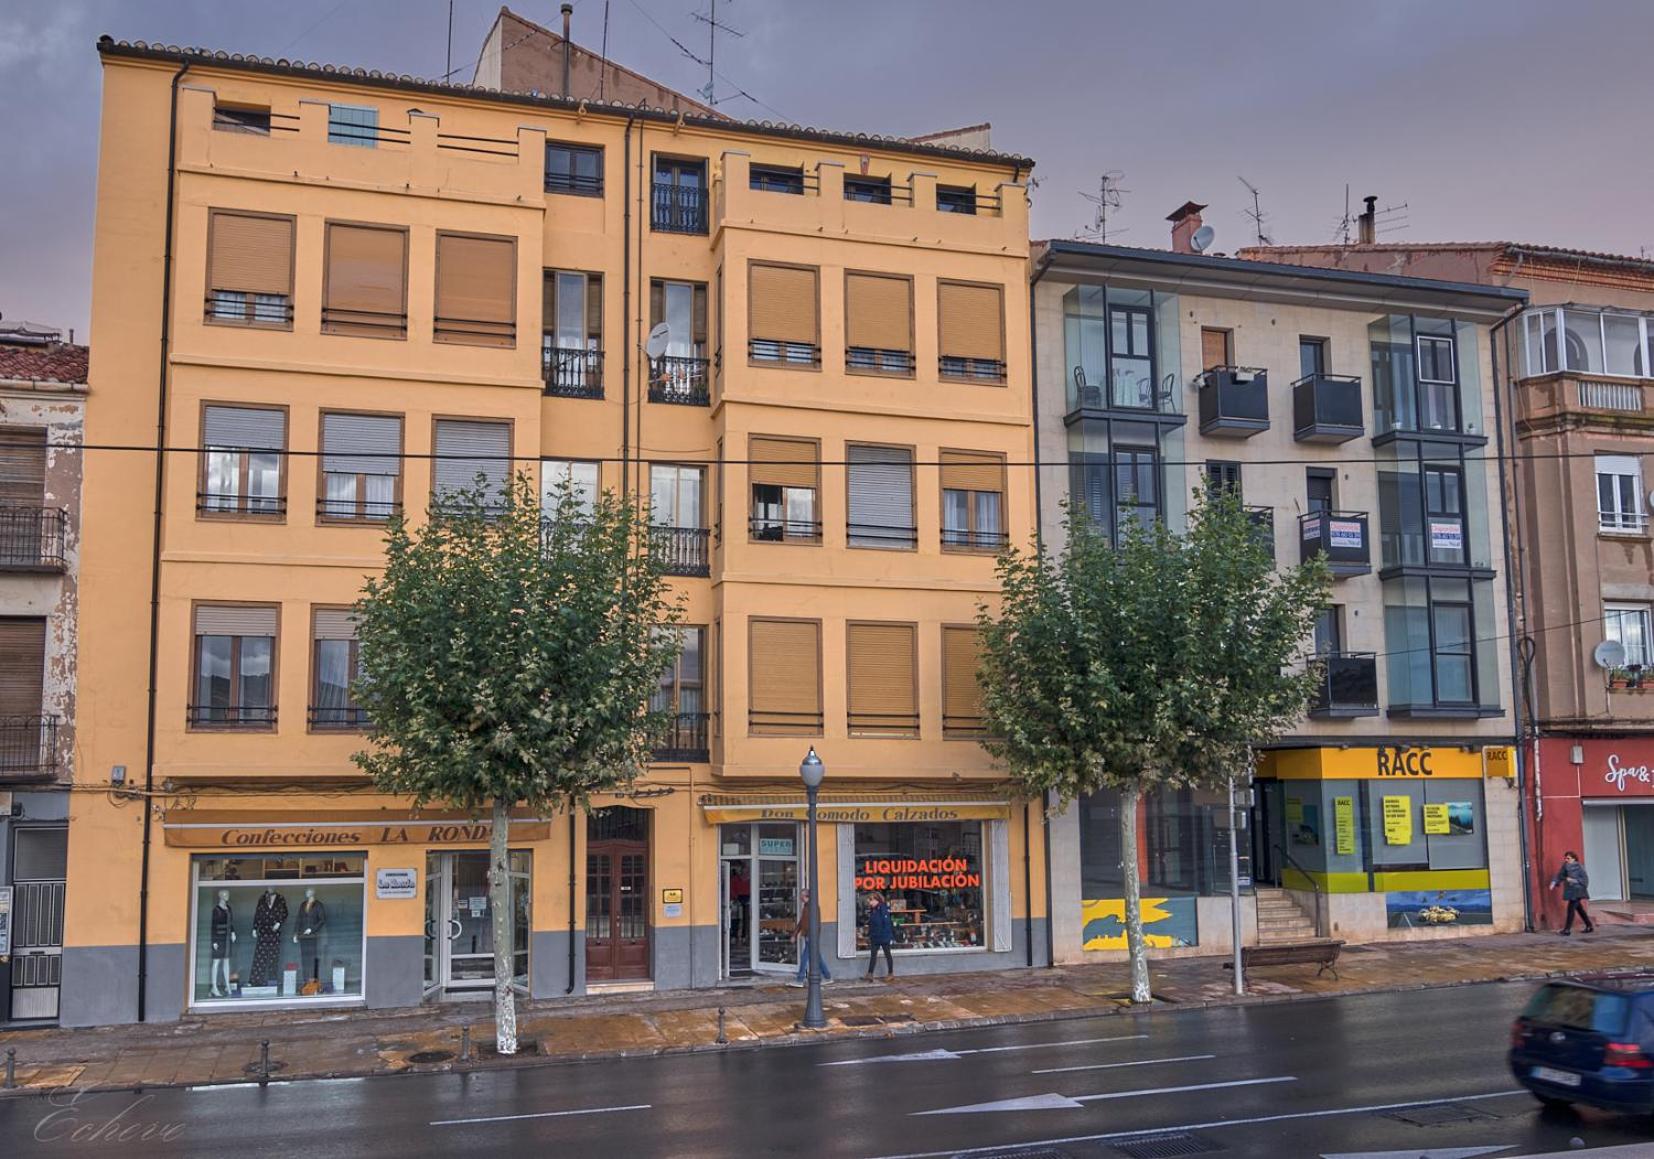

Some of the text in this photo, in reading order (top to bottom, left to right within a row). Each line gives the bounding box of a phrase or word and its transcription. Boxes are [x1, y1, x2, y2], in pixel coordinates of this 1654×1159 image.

[1377, 751, 1433, 776] RACC
[1487, 751, 1508, 761] RACC
[761, 809, 794, 818] Don
[883, 807, 958, 820] Calzados
[221, 826, 493, 844] Confecciones LA ROND
[865, 856, 967, 874] LIQUIDACIÓN
[854, 871, 980, 890] POR JUBILACIÓN
